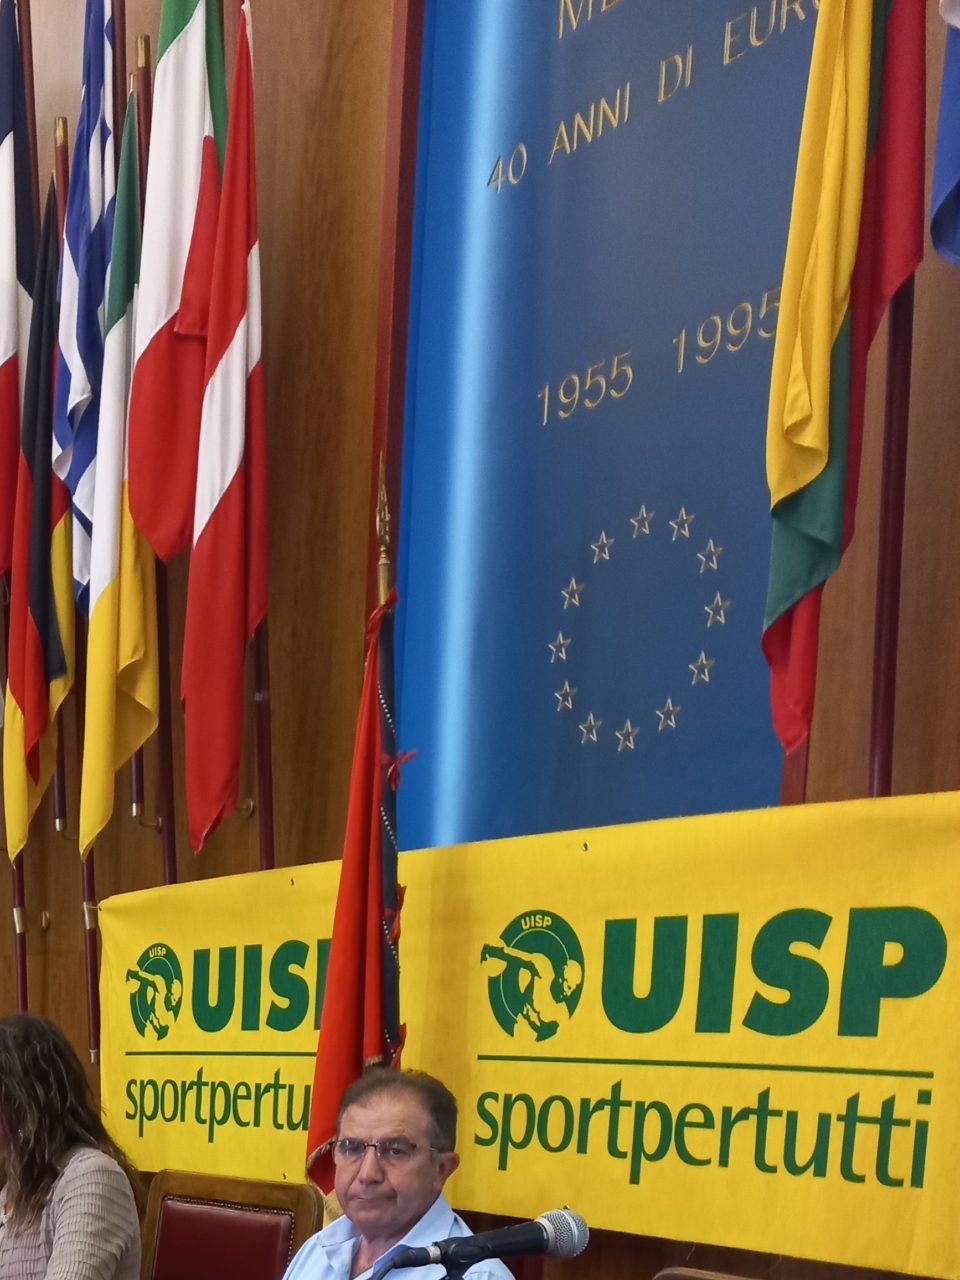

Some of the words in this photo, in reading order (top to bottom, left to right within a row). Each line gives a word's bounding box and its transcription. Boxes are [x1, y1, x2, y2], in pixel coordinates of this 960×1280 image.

[487, 144, 527, 193] 40
[548, 81, 630, 165] ANNI
[658, 45, 692, 103] DI
[723, 0, 819, 65] EUR
[538, 351, 633, 426] 1955
[672, 287, 781, 373] 1995
[149, 946, 166, 958] UISP
[521, 914, 552, 929] UISP
[601, 906, 948, 1037] UISP
[125, 1065, 312, 1144] sportpertu
[474, 1079, 934, 1189] sportpertutti
